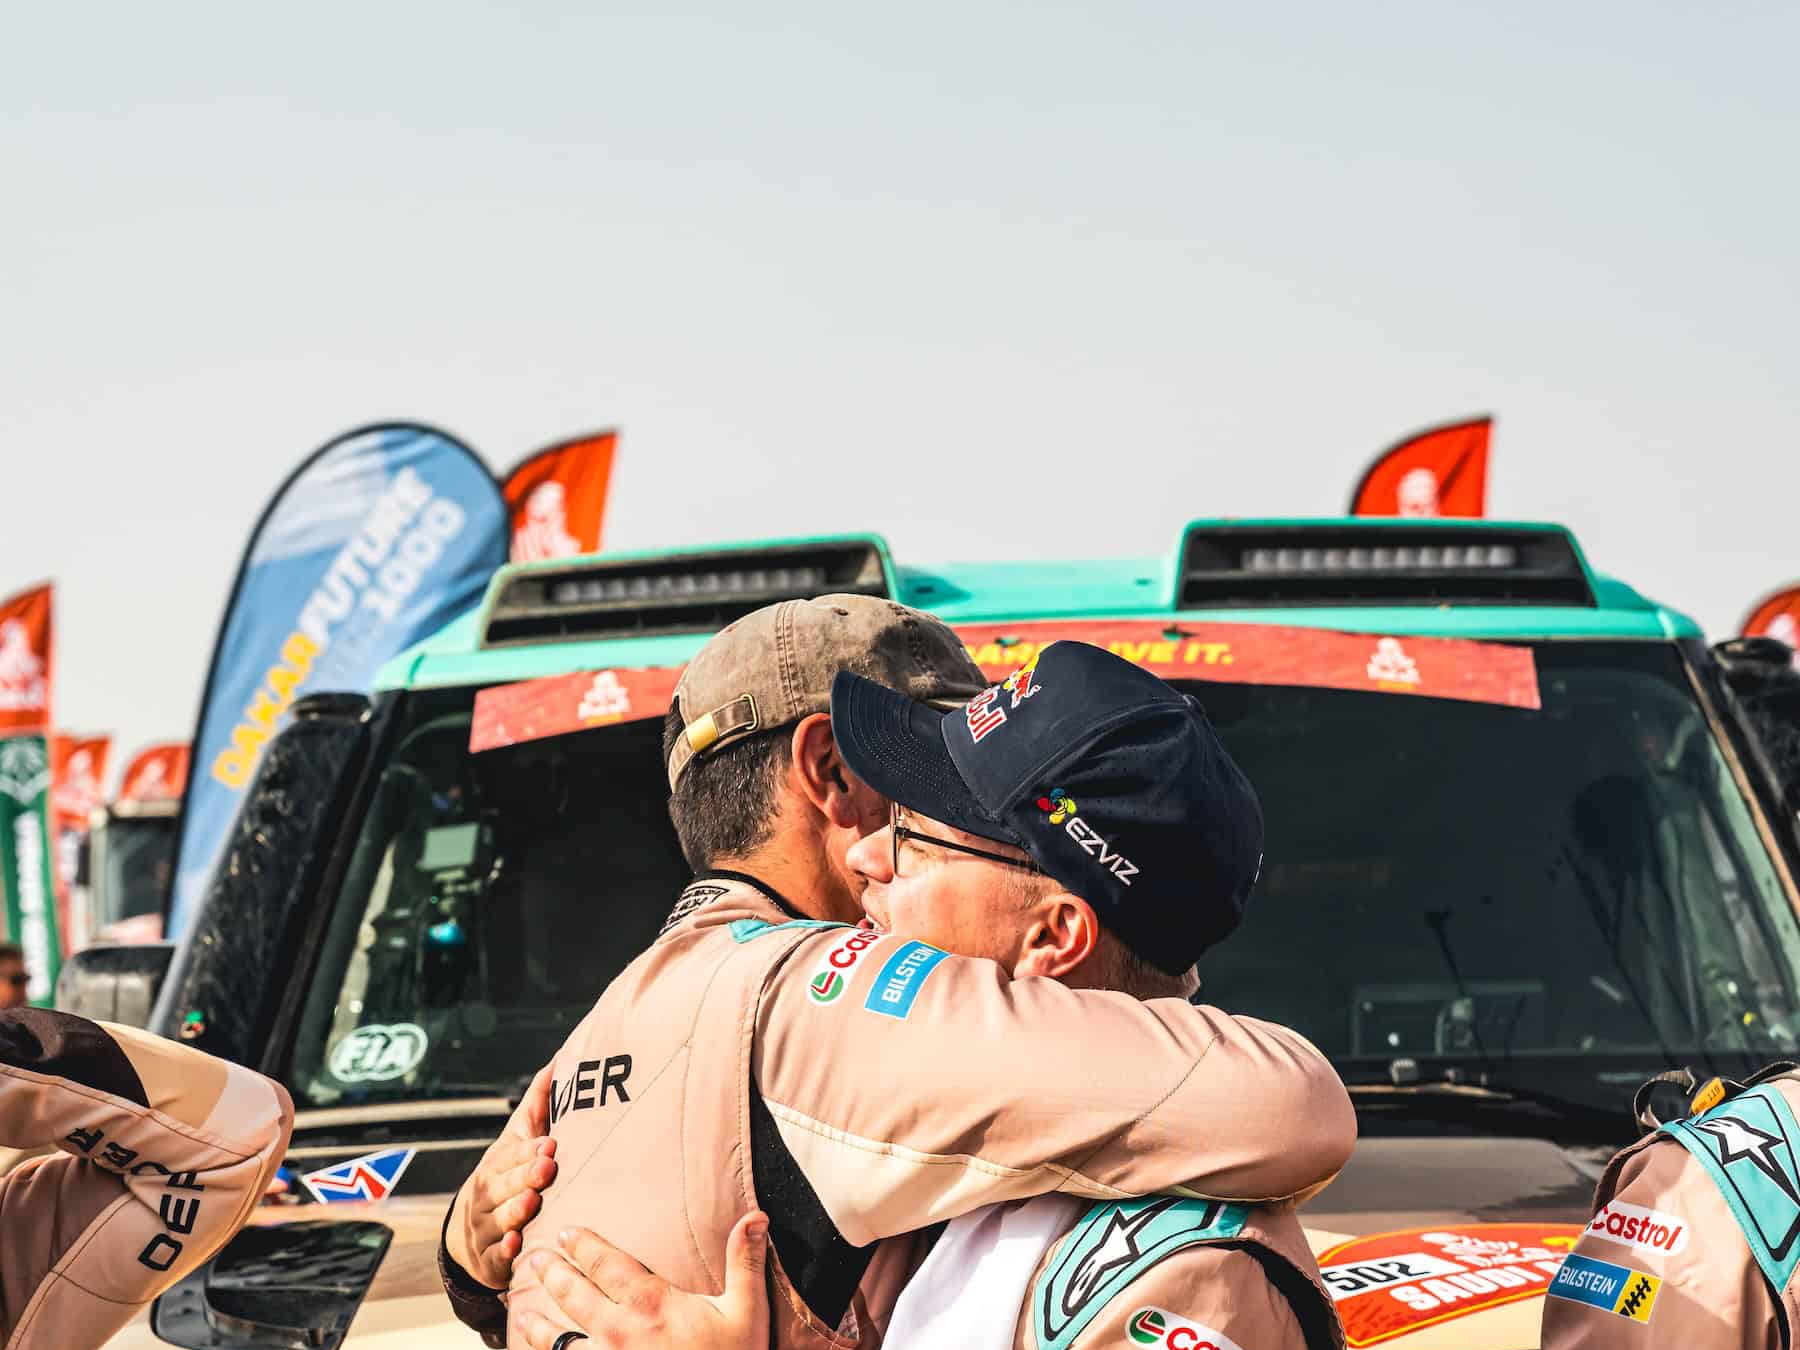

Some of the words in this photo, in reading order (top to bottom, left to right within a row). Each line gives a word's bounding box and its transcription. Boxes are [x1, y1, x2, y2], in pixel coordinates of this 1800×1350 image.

[361, 498, 466, 622] 1000
[1184, 642, 1233, 664] IT.
[210, 632, 322, 790] DAKAR
[1065, 817, 1139, 887] EZVIZ
[335, 1032, 413, 1074] FIA
[1320, 1261, 1432, 1292] 502
[1389, 1265, 1546, 1311] SAUDI
[1558, 1266, 1618, 1297] BILSTEIN
